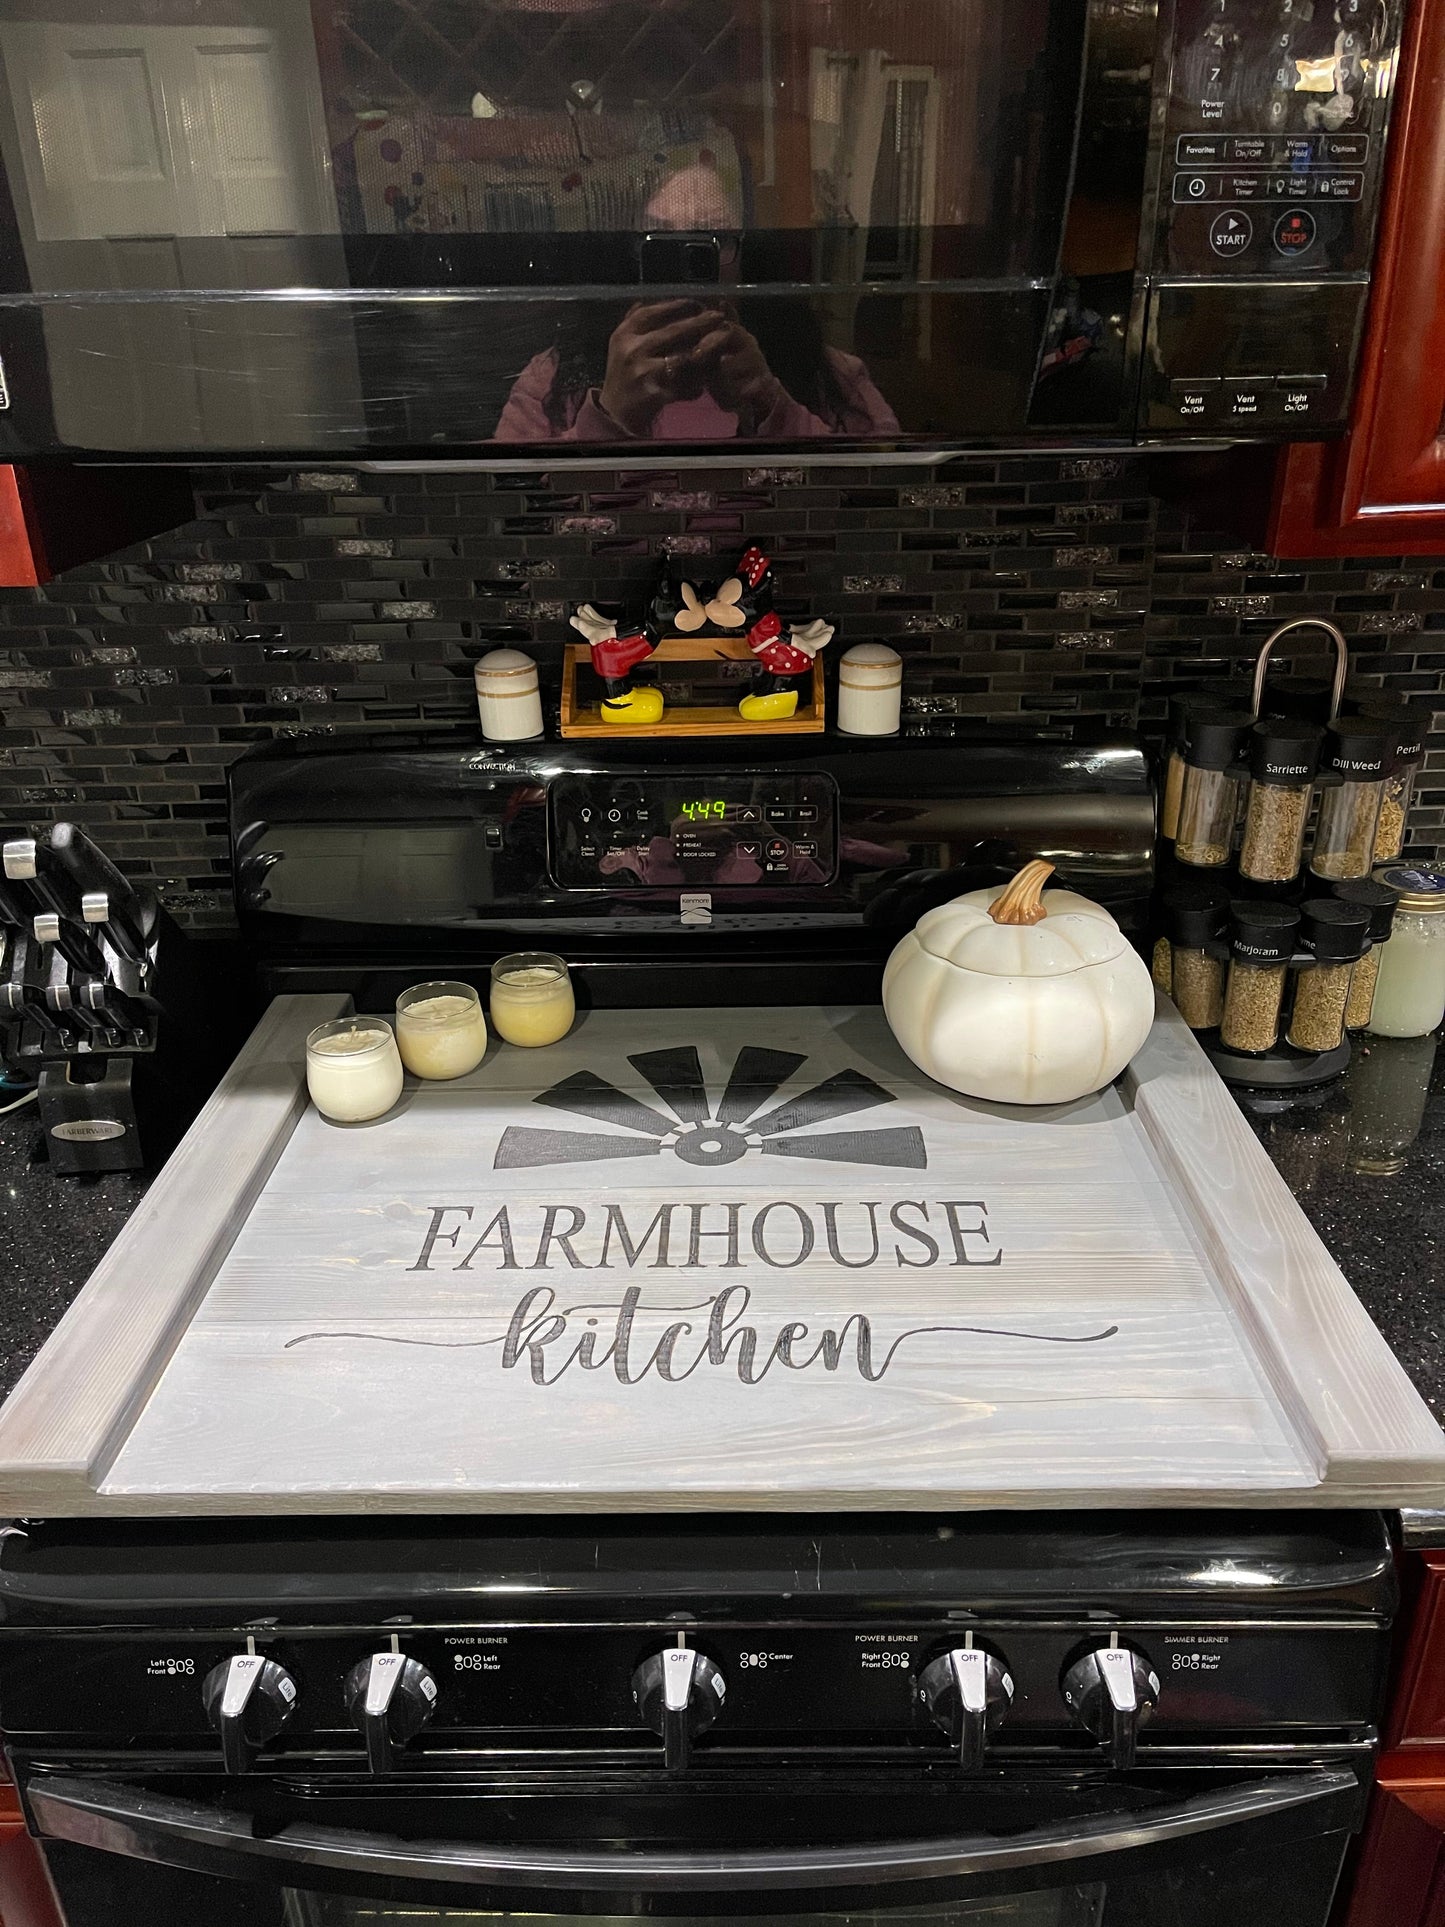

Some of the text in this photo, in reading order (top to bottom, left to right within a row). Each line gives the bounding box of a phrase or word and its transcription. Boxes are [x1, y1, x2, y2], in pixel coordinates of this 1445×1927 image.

[1220, 0, 1226, 12] 1
[1284, 0, 1293, 12] 2
[1349, 0, 1359, 12] 3
[1214, 34, 1224, 49] 4
[1280, 33, 1290, 48] 5
[1345, 33, 1355, 48] 6
[1210, 68, 1221, 81] 7
[1276, 68, 1286, 82] 8
[1201, 100, 1225, 109] Power
[1272, 102, 1282, 116] 0
[1202, 110, 1223, 118] Level
[1234, 140, 1265, 149] Turntable
[1287, 141, 1308, 149] Warm
[1186, 146, 1215, 154] Favorites
[1292, 149, 1308, 158] Hold
[1330, 145, 1357, 154] Options
[1235, 150, 1262, 159] On/Off
[1233, 179, 1258, 187] Kitchen
[1290, 179, 1307, 189] Light
[1331, 179, 1355, 187] Control
[1236, 188, 1253, 196] Timer
[1288, 188, 1307, 196] Timer
[1334, 188, 1349, 196] Lock
[1216, 234, 1246, 246] START
[1280, 233, 1307, 245] STOP
[1184, 395, 1203, 405] Vent
[1236, 394, 1255, 403] Vent
[1287, 393, 1307, 404] Light
[1180, 405, 1205, 414] On/Off
[1232, 405, 1257, 414] 5 speed
[1284, 403, 1309, 412] On/Off
[1396, 743, 1421, 755] Persil
[469, 762, 516, 771] CONVECTION
[1266, 762, 1309, 775] Sarriette
[1332, 758, 1382, 771] Dill Weed
[682, 801, 725, 821] 4:49
[1233, 939, 1279, 957] Marjoram
[405, 1200, 1002, 1272] FARMHOUSE
[502, 1284, 898, 1386] kitchen
[444, 1637, 508, 1645] POWER BURNER
[855, 1634, 919, 1643] POWER BURNER
[1164, 1636, 1229, 1644] SIMMER BURNER
[670, 1653, 688, 1662] OFF
[768, 1652, 794, 1660] Center
[861, 1652, 881, 1662] Right
[961, 1653, 978, 1662] OFF
[1106, 1653, 1124, 1662] OFF
[1201, 1654, 1221, 1663] Right
[149, 1659, 166, 1667] Left
[237, 1660, 256, 1668] OFF
[378, 1657, 397, 1666] OFF
[861, 1660, 882, 1669] Front
[1201, 1662, 1219, 1670] Rear
[147, 1667, 167, 1675] Front
